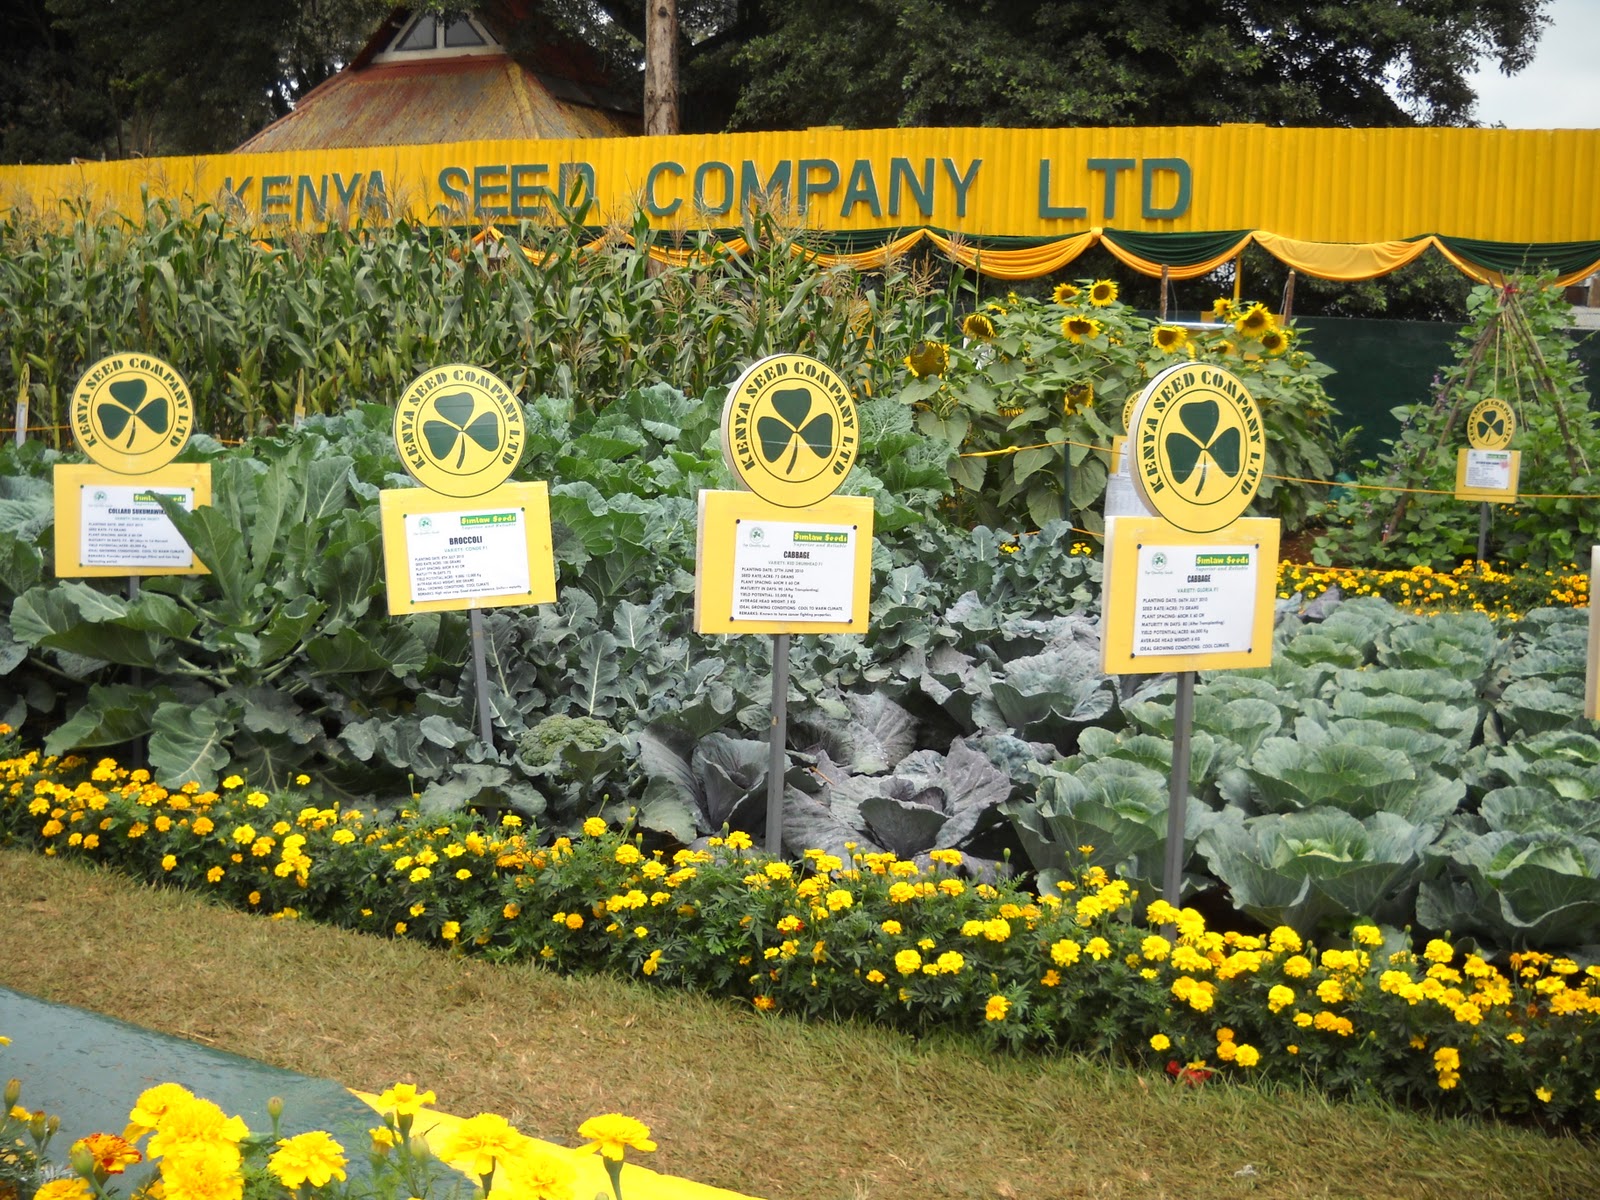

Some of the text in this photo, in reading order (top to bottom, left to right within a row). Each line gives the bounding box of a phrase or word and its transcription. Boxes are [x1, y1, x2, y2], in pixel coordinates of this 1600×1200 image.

[223, 157, 1193, 224] KENYA SEED COMPANY LTD
[78, 358, 188, 447] KENYA SEED COMPANY LTD
[402, 370, 520, 469] KENYA SEED COMPANY LTD
[735, 362, 854, 475] KENYA SEED COMPANY LTD
[1144, 371, 1261, 495] KENYA SEED COMPANY LTD
[449, 536, 482, 545] BROCCOLI
[784, 551, 810, 559] CABBAGE
[795, 532, 822, 541] Simlaw
